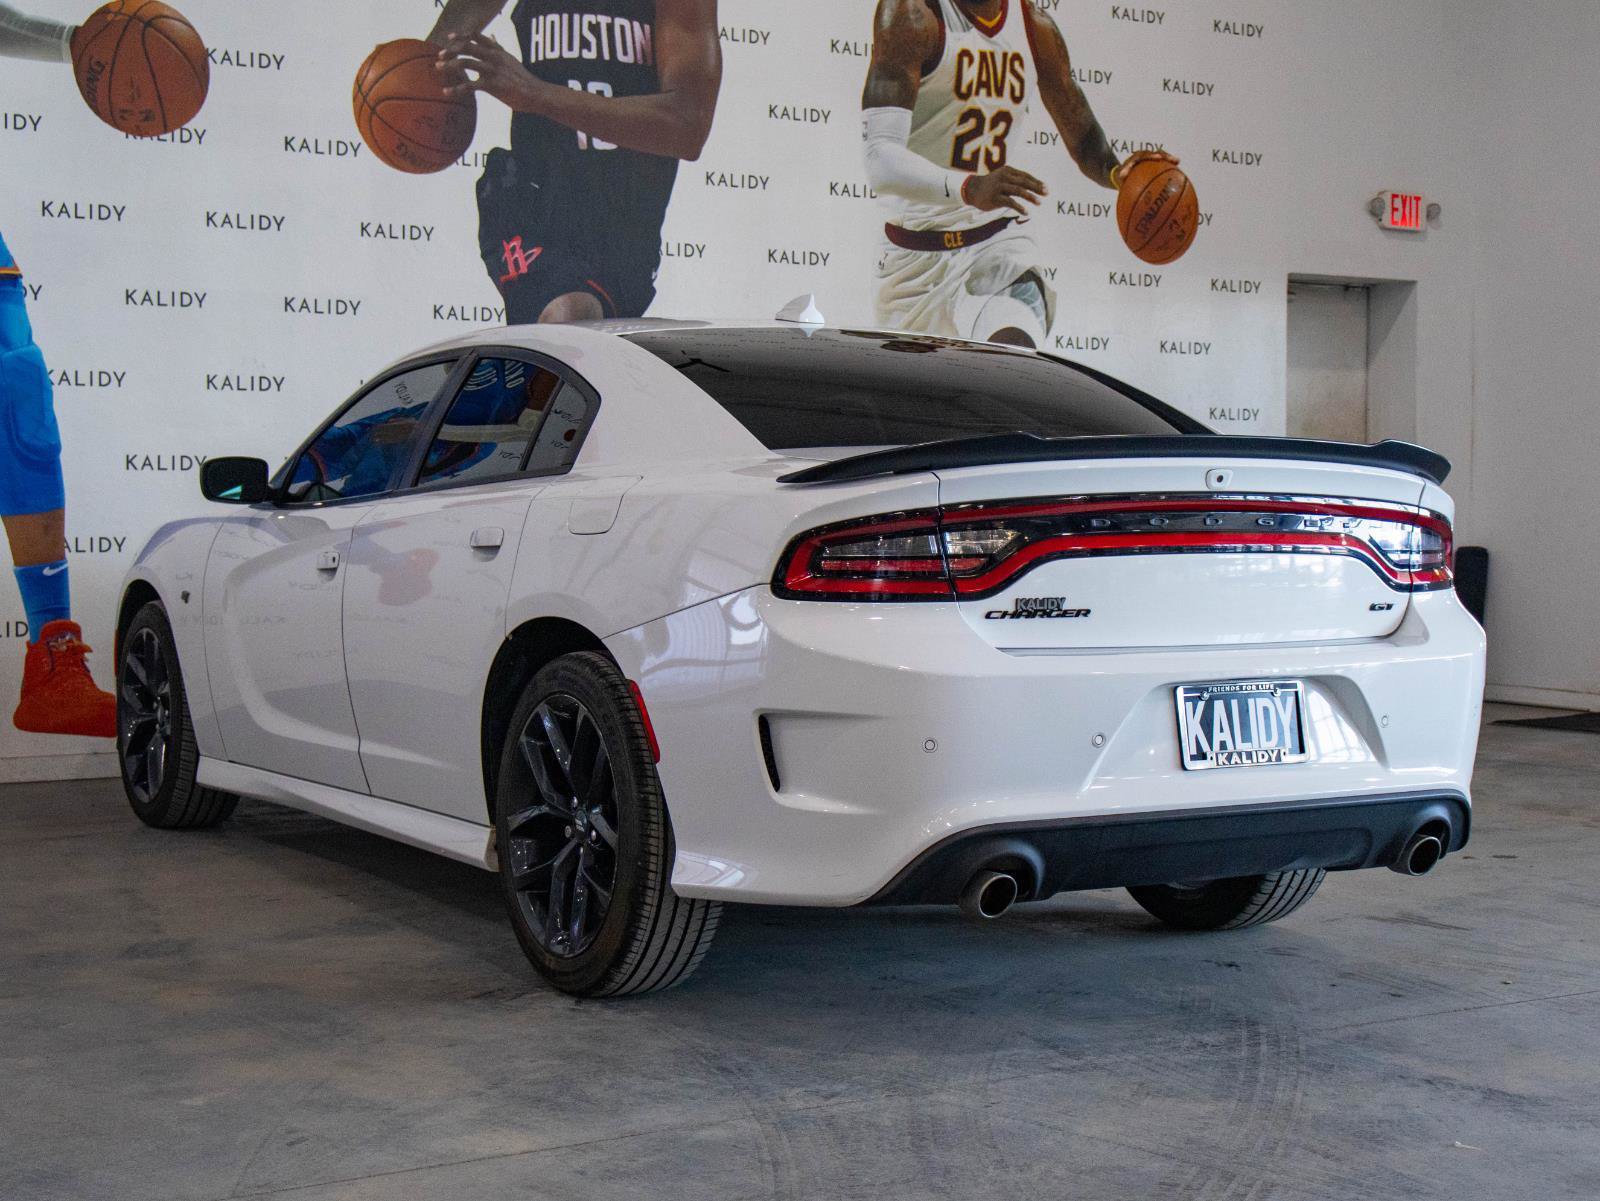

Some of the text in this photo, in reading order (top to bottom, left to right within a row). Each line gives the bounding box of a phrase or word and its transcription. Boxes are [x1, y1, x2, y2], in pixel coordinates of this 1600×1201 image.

[1112, 5, 1165, 24] KALIDY
[720, 27, 770, 45] ALIDY
[1213, 19, 1263, 38] KALIDY
[530, 13, 653, 65] HOUSTON
[830, 39, 873, 57] KALI
[207, 48, 285, 71] KALIDY
[953, 48, 1026, 105] CAVS
[1070, 66, 1112, 85] ALIDY
[1162, 77, 1214, 97] KALIDY
[3, 112, 42, 132] IDY
[769, 104, 831, 123] KALIDY
[284, 136, 361, 158] KALIDY
[950, 105, 1014, 176] 23
[1212, 148, 1262, 167] KALIDY
[705, 171, 770, 191] KALIDY
[41, 201, 126, 222] KALIDY
[1057, 200, 1111, 218] KALIDY
[1391, 194, 1422, 229] EXIT
[206, 212, 285, 232] KALIDY
[360, 223, 434, 241] KALIDY
[943, 232, 964, 248] CLE
[659, 240, 705, 259] LIDY
[768, 248, 830, 267] KALIDY
[1109, 271, 1162, 288] KALIDY
[1211, 278, 1261, 295] KALIDY
[125, 289, 206, 309] KALIDY
[284, 297, 361, 316] KALIDY
[434, 305, 505, 322] KALIDY
[1055, 335, 1109, 352] KALIDY
[1160, 340, 1212, 355] KALIDY
[206, 374, 285, 393] KALIDY
[1209, 407, 1259, 422] KALIDY
[125, 454, 207, 472] KALIDY
[64, 536, 127, 554] ALIDY
[1015, 597, 1067, 611] KALIDY
[1369, 602, 1394, 611] GT
[984, 608, 1092, 620] CHARGER
[1208, 683, 1275, 693] FRIENDS FOR LIFE
[1185, 696, 1295, 755] KALIDY
[1218, 749, 1279, 766] KALIDY
